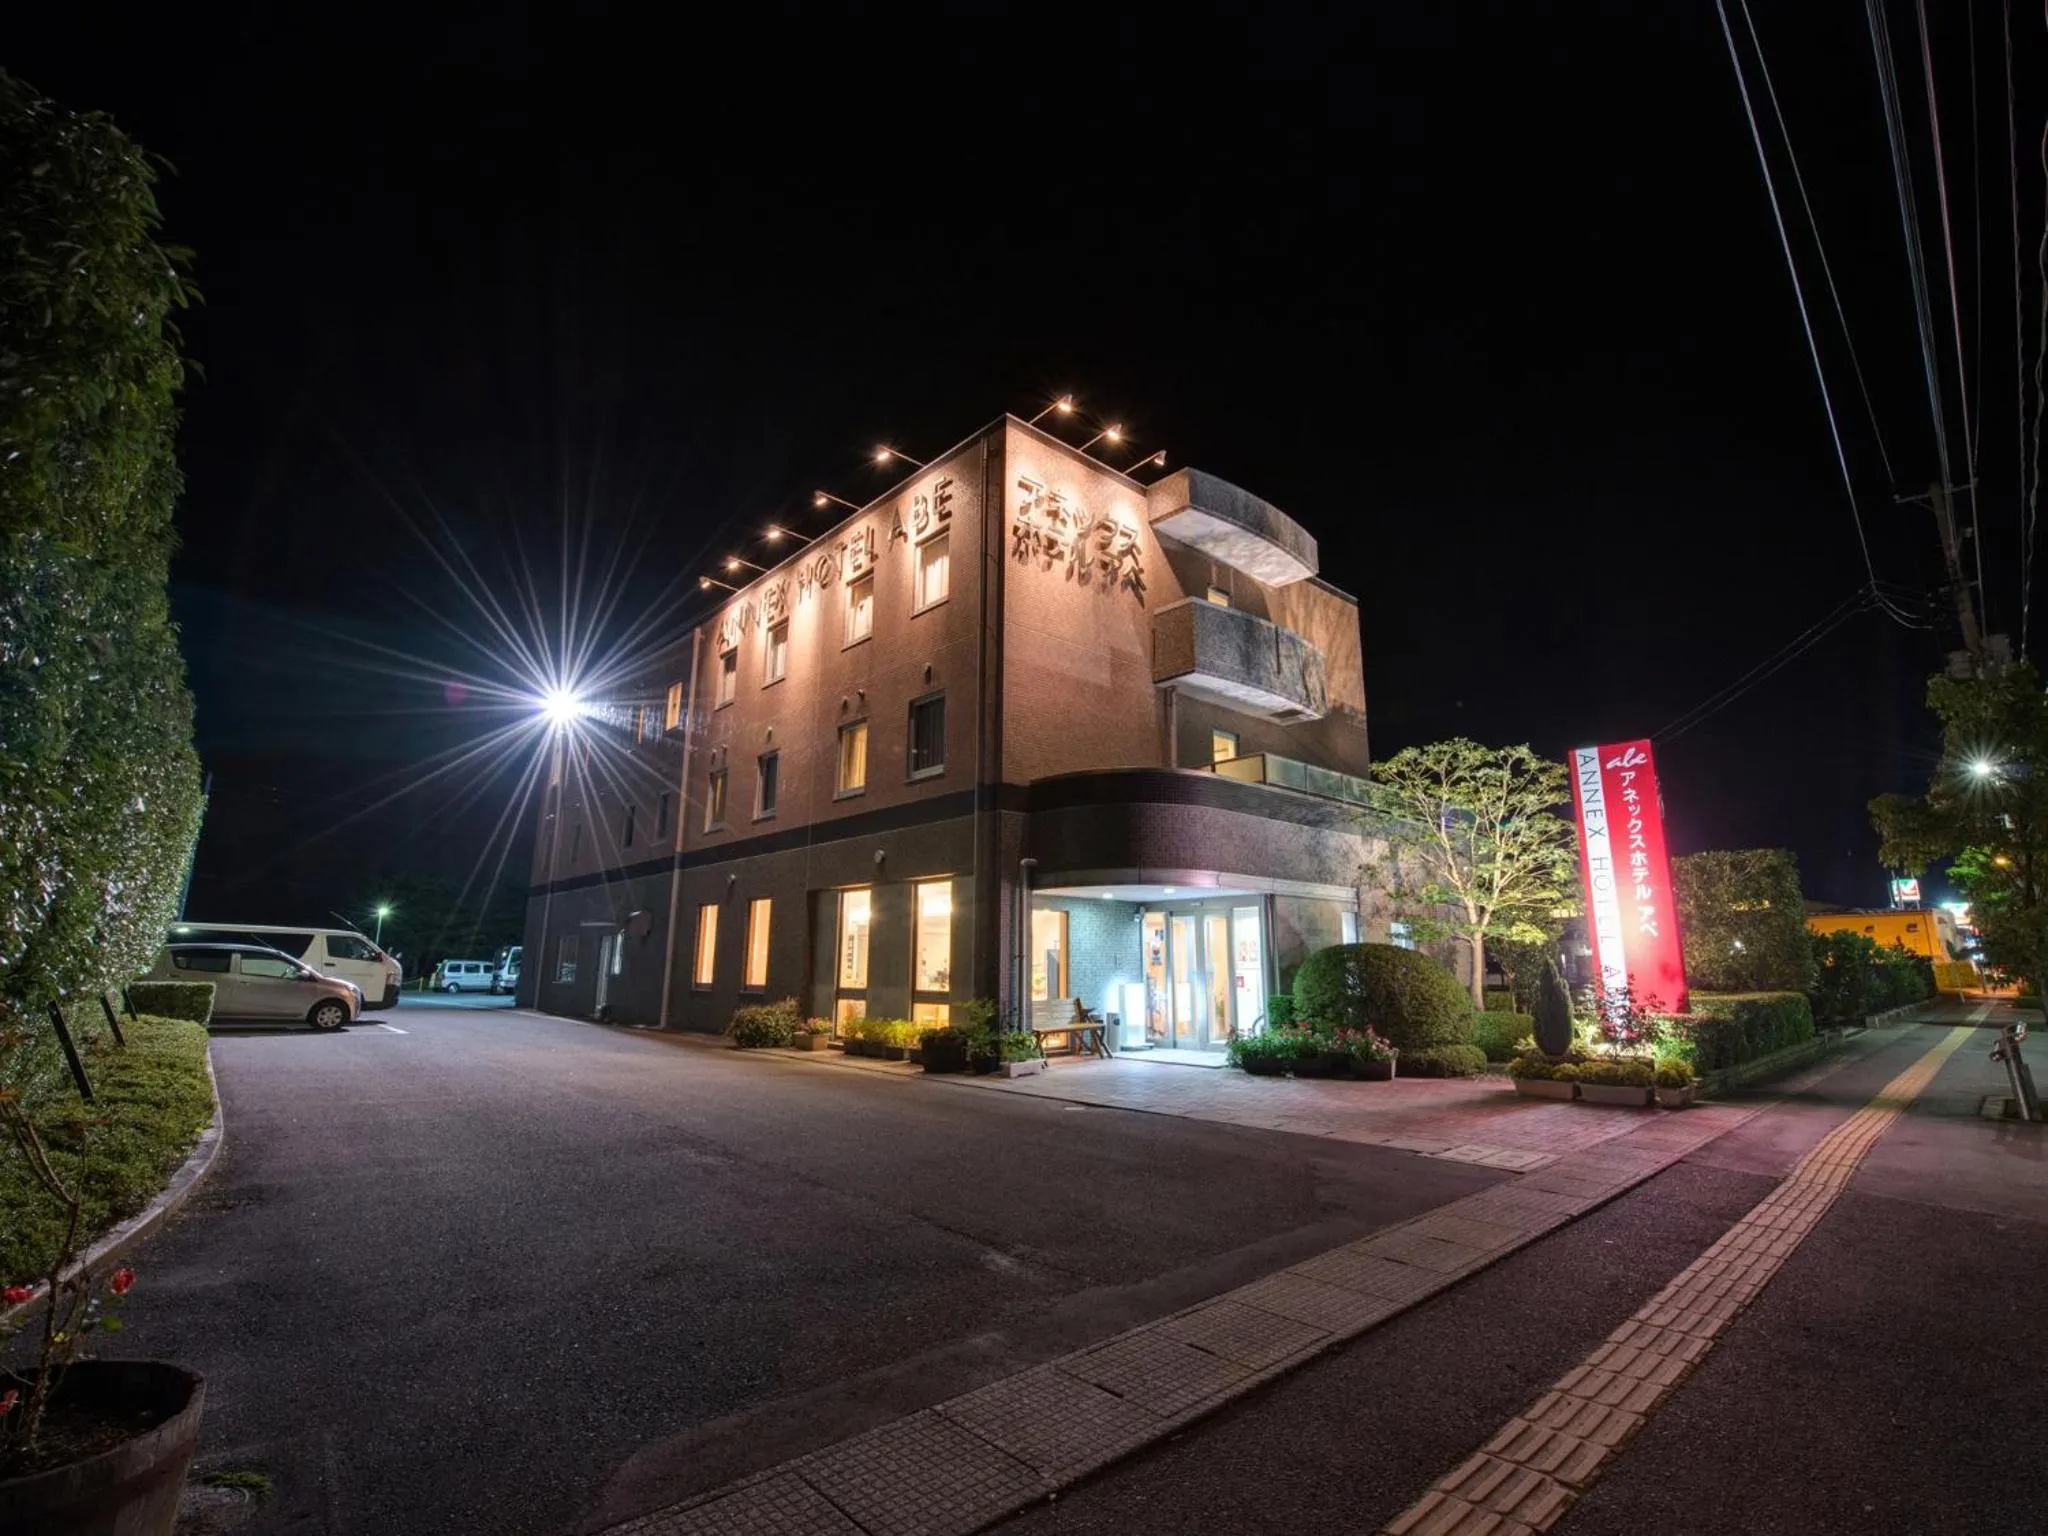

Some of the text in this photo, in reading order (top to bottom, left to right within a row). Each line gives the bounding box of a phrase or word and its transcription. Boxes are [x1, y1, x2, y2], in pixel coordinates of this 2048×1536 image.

[717, 475, 953, 650] ANNEX HOTEL ABE
[1579, 754, 1606, 838] ANNEX
